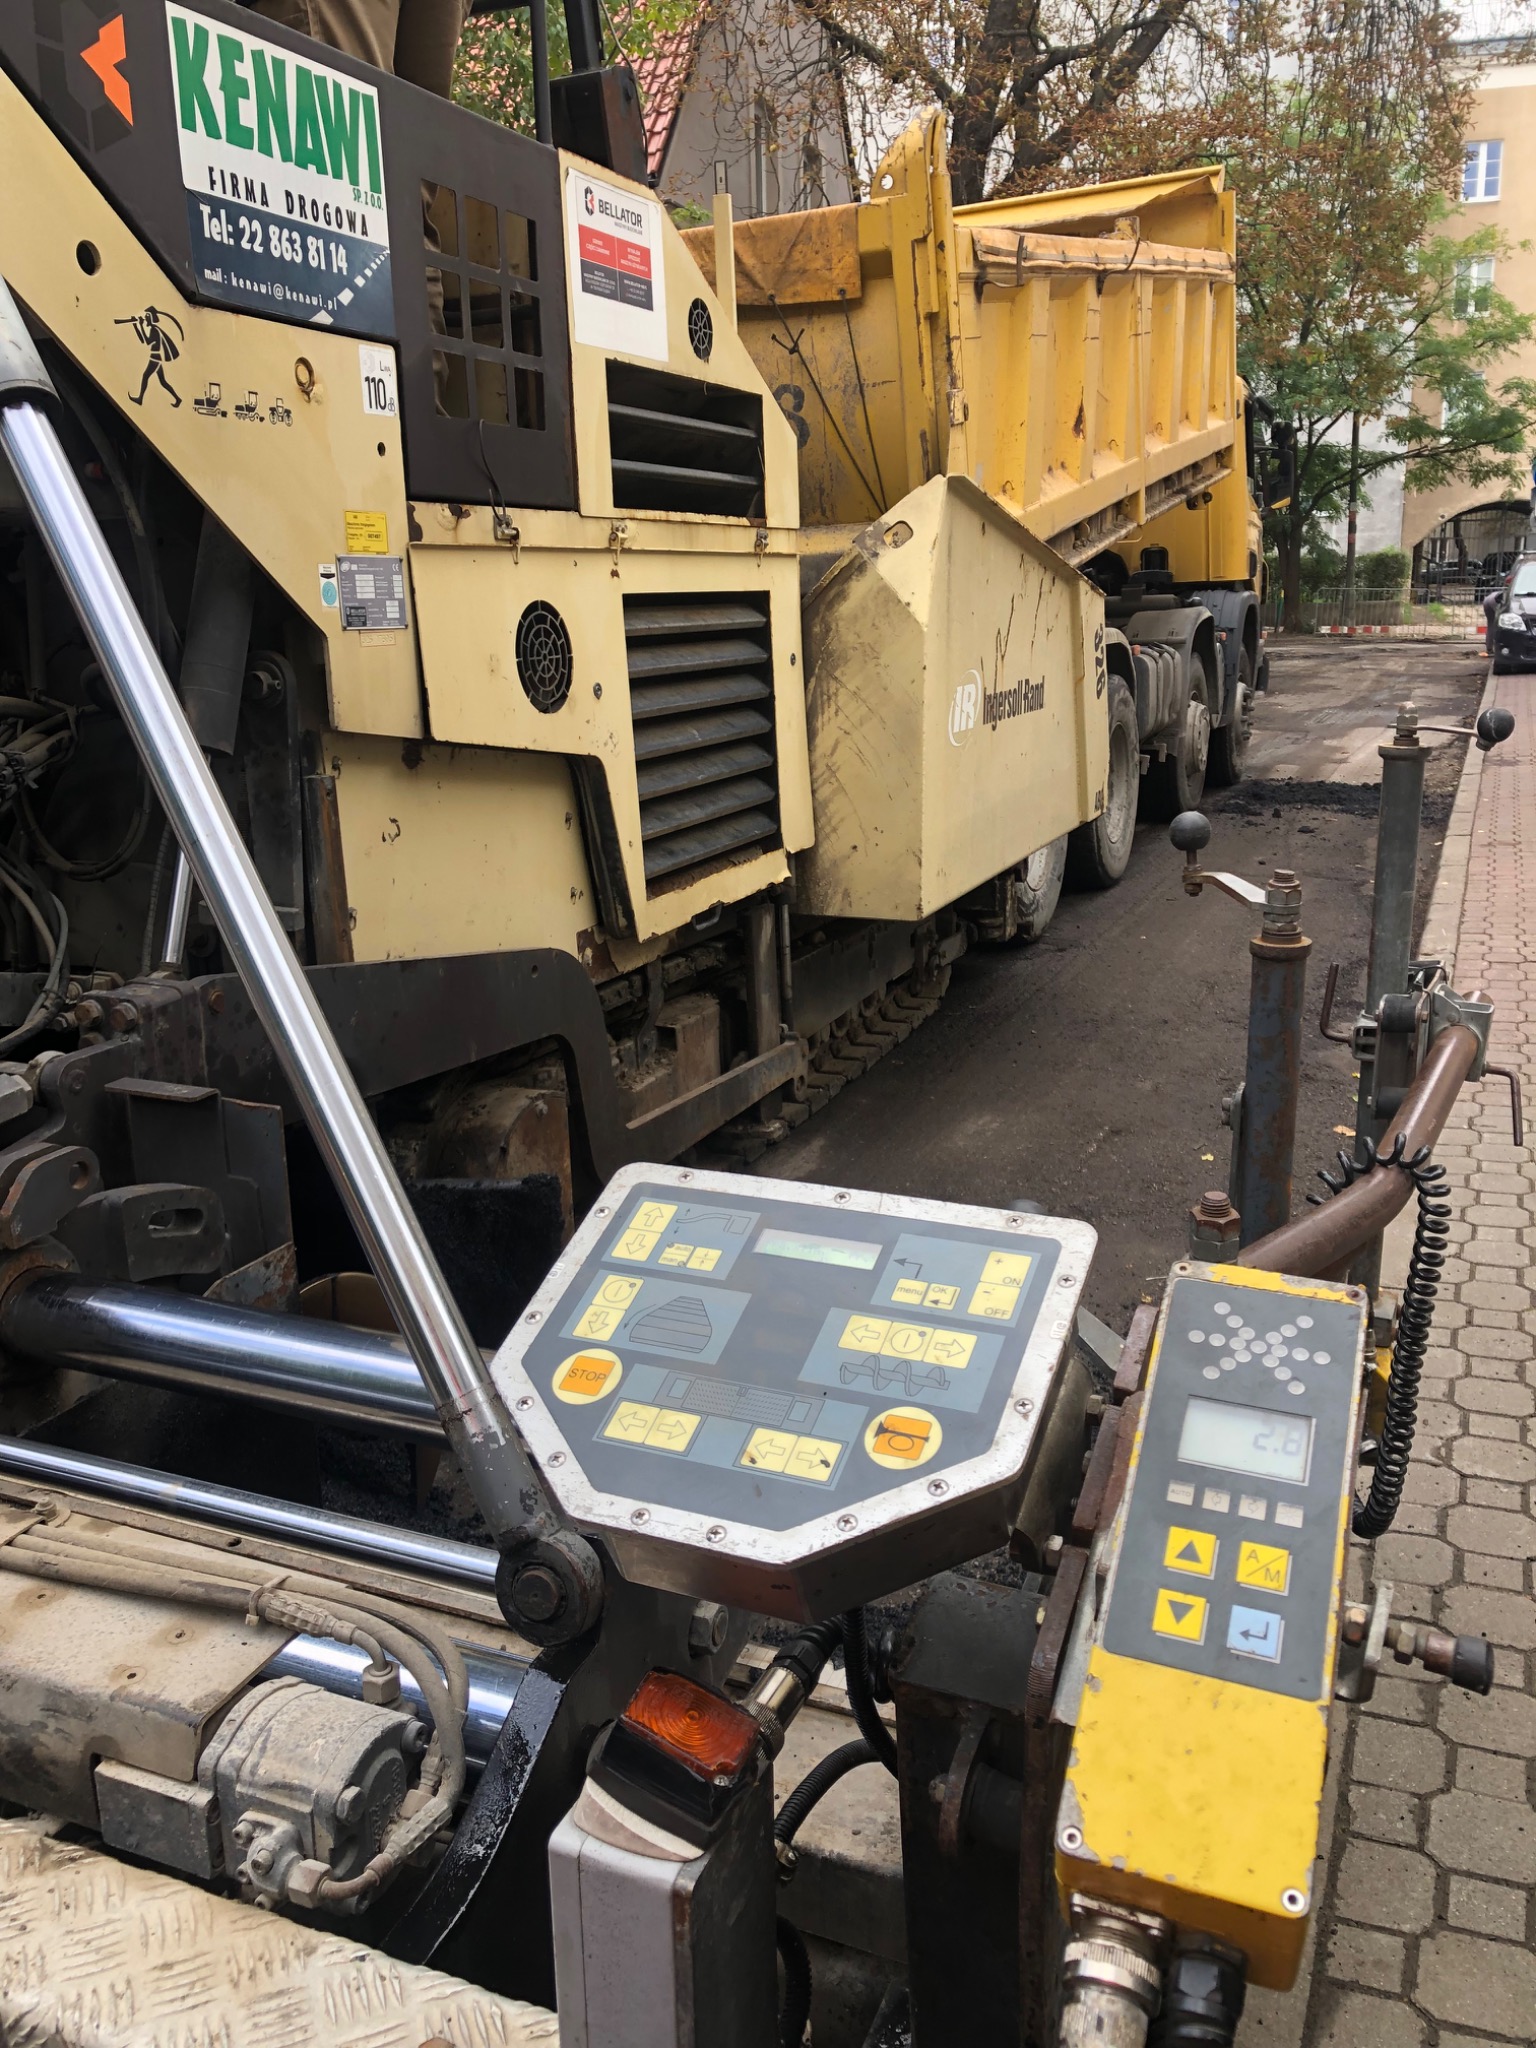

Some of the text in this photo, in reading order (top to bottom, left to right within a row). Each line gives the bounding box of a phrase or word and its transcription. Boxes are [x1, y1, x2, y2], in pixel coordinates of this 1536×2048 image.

[171, 15, 382, 195] KENAWI
[207, 165, 369, 238] FIRMA DROGOWA
[598, 199, 643, 228] BELLATOR
[200, 203, 348, 276] Tel: 22 863 81 14
[364, 375, 387, 411] 110
[953, 683, 977, 734] IR
[896, 1285, 923, 1297] menu
[932, 1286, 949, 1295] OK
[1002, 1276, 1022, 1287] ON
[984, 1307, 1010, 1318] OFF
[568, 1367, 607, 1383] STOP
[1170, 1488, 1192, 1498] AUTO
